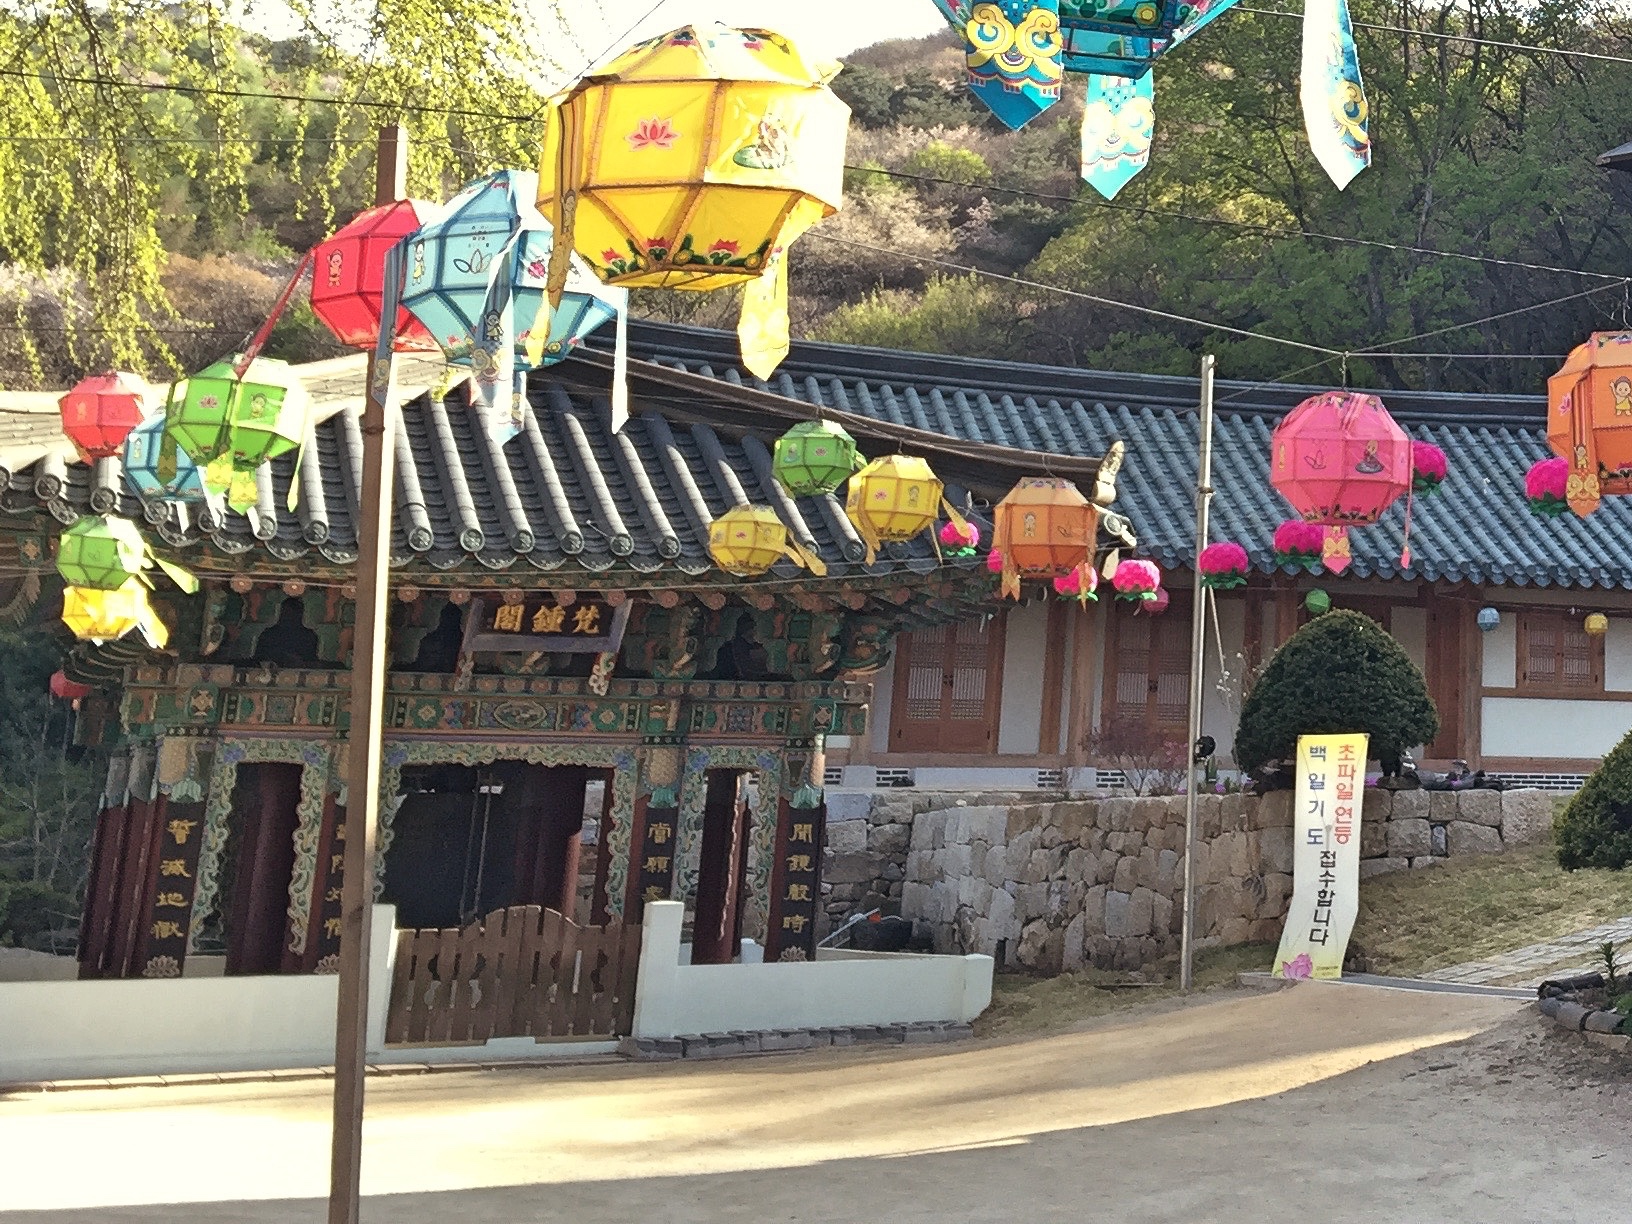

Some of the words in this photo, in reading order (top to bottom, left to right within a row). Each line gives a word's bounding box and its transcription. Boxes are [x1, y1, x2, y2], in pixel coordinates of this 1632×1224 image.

[1306, 745, 1327, 846] 백일기도
[1334, 744, 1357, 845] 초파일연등
[1308, 850, 1337, 947] 접수합니다
